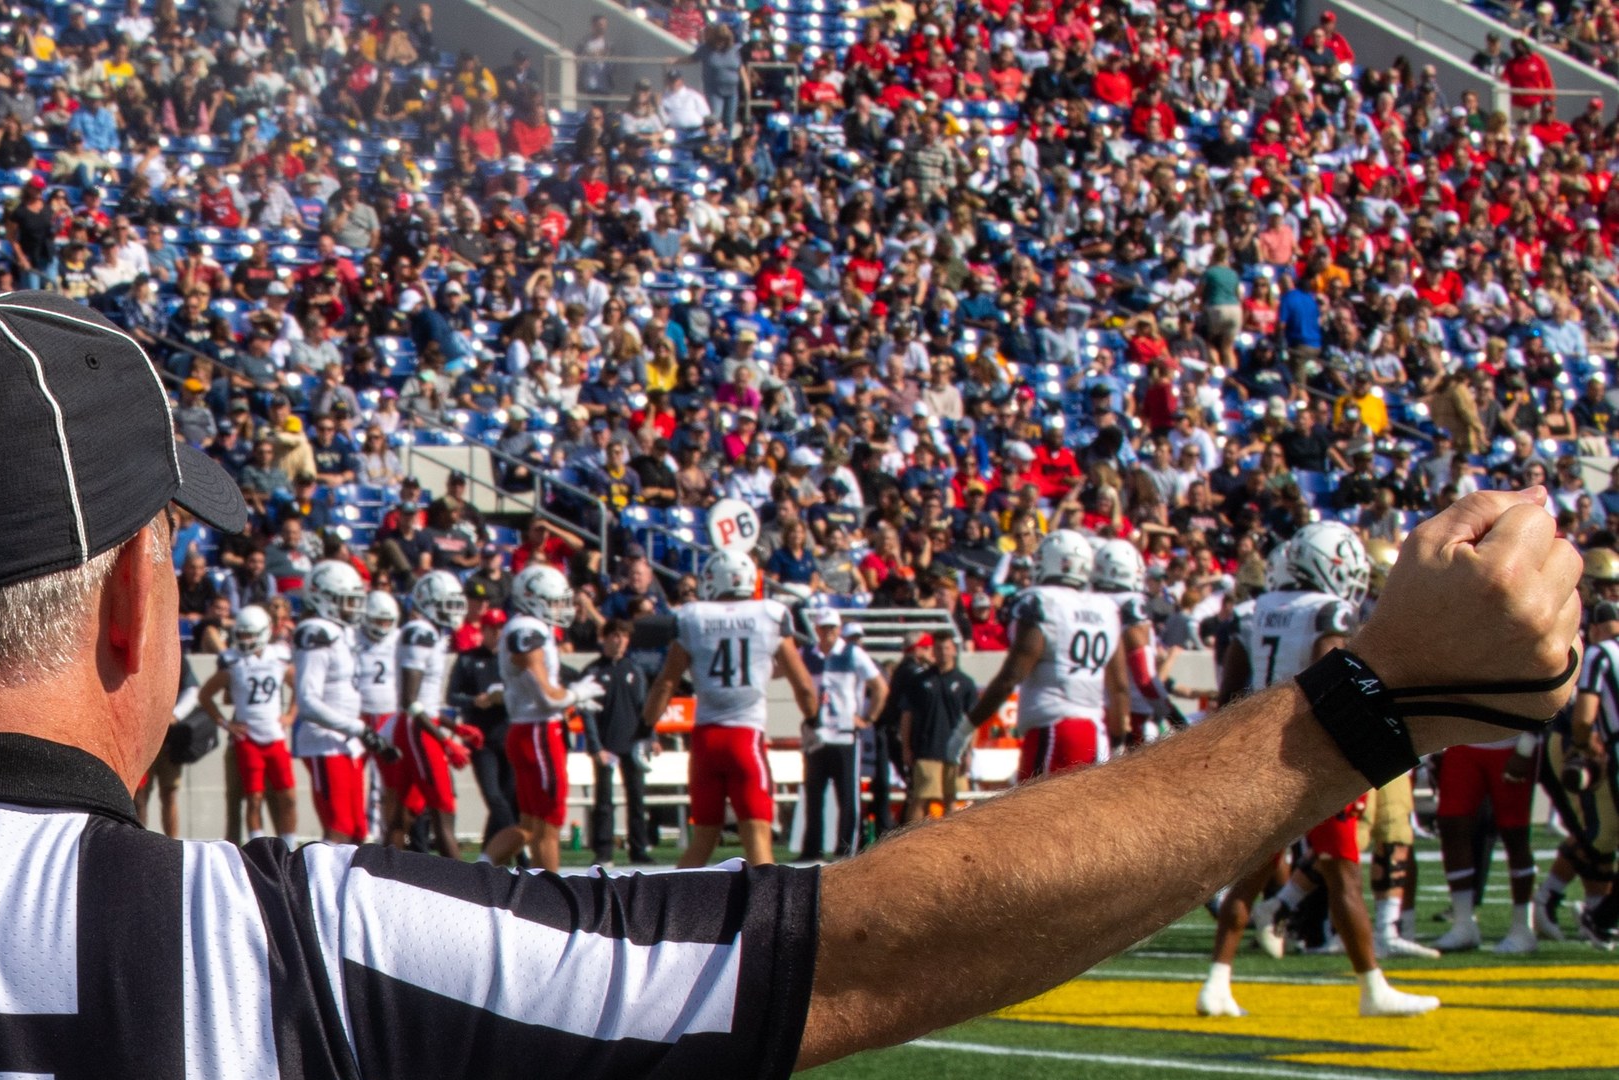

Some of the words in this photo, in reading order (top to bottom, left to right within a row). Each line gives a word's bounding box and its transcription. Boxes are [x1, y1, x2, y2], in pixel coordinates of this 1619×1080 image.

[716, 512, 756, 546] P6
[372, 661, 386, 684] 2
[707, 637, 752, 688] 41
[1068, 629, 1109, 676] 99
[1261, 635, 1281, 687] 7
[247, 675, 277, 704] 29
